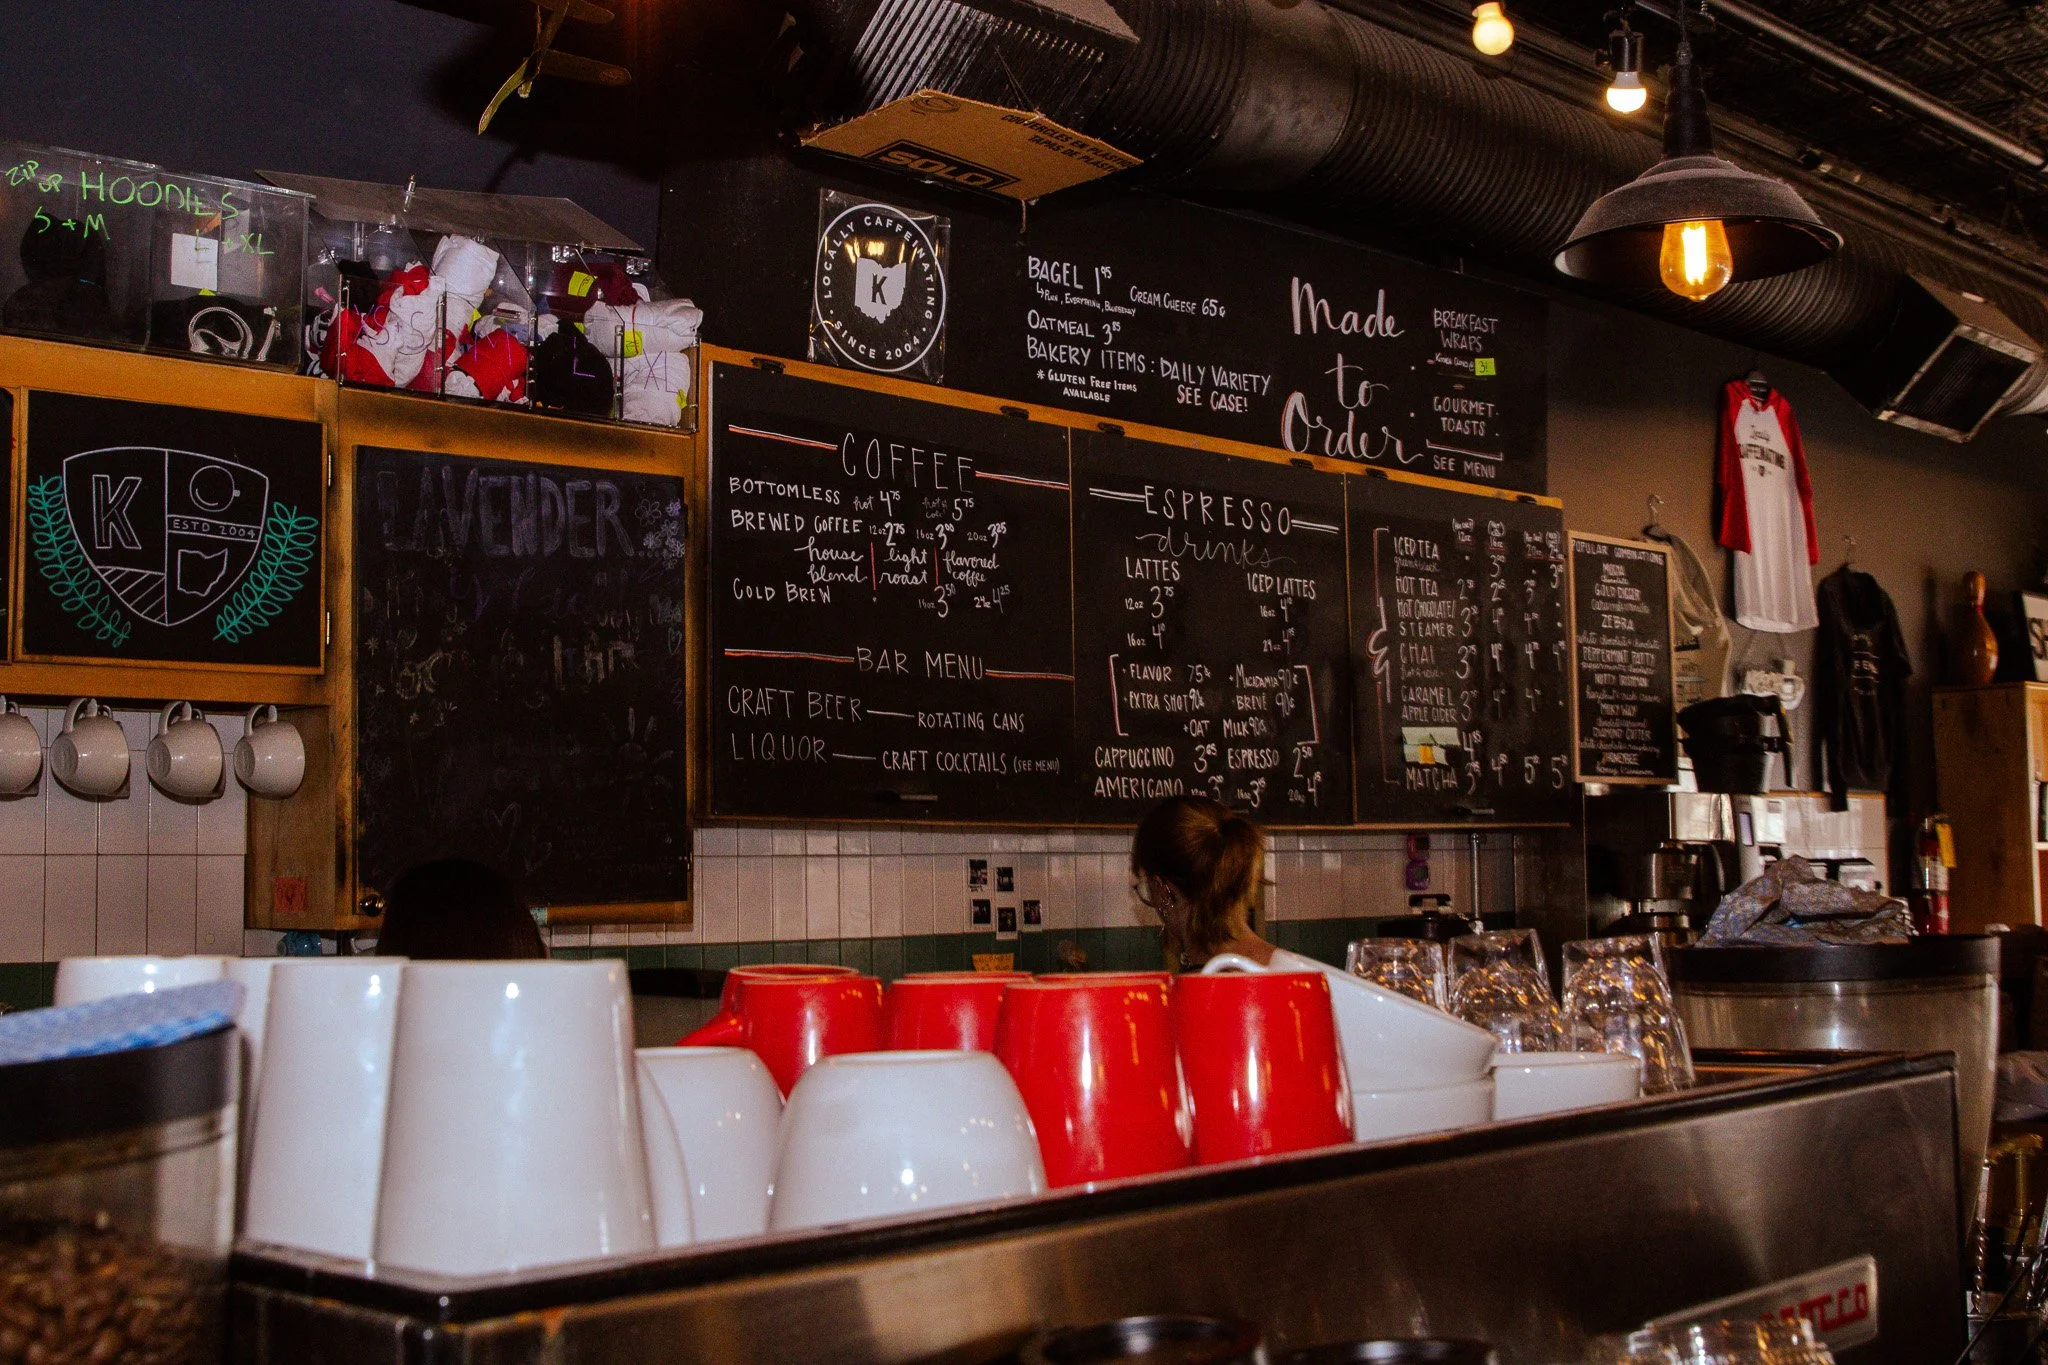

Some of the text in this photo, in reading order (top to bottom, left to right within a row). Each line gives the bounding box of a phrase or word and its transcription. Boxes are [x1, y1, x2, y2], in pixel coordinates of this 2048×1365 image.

[879, 150, 994, 186] SOLO
[82, 171, 240, 220] HOODIES
[83, 213, 111, 241] M
[239, 232, 274, 255] XL
[822, 216, 936, 320] LOCALLY CAFFEINATING
[1028, 256, 1084, 290] BAGEL
[871, 273, 888, 306] K
[1291, 276, 1406, 338] Made
[1433, 307, 1499, 334] BREAKFAST
[1027, 309, 1095, 338] OATMEAL
[833, 320, 921, 361] SINCE 2004
[1440, 330, 1483, 352] WRAPS
[573, 336, 596, 378] L
[642, 348, 678, 394] XL
[1027, 334, 1091, 367] BAKERY
[1160, 356, 1206, 386] DAILY
[1211, 365, 1272, 397] VARIETY
[1063, 387, 1111, 403] AVAILABLE
[1324, 352, 1390, 410] to
[1177, 385, 1249, 414] SEE CASE!
[1433, 396, 1495, 418] GOURMET
[1281, 390, 1424, 464] Order
[1440, 416, 1486, 437] TOASTS
[842, 432, 973, 493] COFFEE
[1433, 455, 1495, 479] SEE MENU
[729, 477, 840, 505] BOTTOMLESS
[853, 495, 874, 511] hot
[92, 474, 143, 550] K
[731, 509, 805, 532] BREWED
[814, 515, 863, 535] COFFEE
[1144, 485, 1291, 536] ESPRESSO
[172, 519, 257, 539] ESTD 2004
[797, 536, 1000, 577] house light flavored
[1135, 526, 1297, 569] drinks
[1394, 536, 1439, 560] ICED TEA
[807, 564, 986, 587] blend roast coffee
[1125, 557, 1181, 582] LATTES
[1276, 576, 1316, 600] LATTES
[1396, 576, 1439, 597] HOT TEA
[733, 578, 775, 602] COLD
[786, 581, 831, 603] BREW
[1400, 621, 1455, 638] STEAMER
[1601, 614, 1635, 631] ZEBRA
[856, 646, 983, 680] BAR MENU
[1400, 643, 1435, 664] CHAI
[1129, 663, 1172, 681] FLAVOR
[728, 685, 1024, 733] CRAFT BEER ROTATING CANS
[1129, 690, 1160, 710] EXTRA
[1163, 694, 1188, 712] SHOT
[1401, 685, 1455, 707] CARAMEL
[1402, 705, 1458, 722] APPLE CIDER
[1223, 718, 1249, 738] MILK
[732, 732, 827, 763] LIQUOR
[882, 750, 928, 772] CRAFT
[936, 751, 1007, 774] COCKTAILS
[1095, 746, 1174, 768] CAPPUCCINO
[1227, 748, 1279, 769] ESPRESSO
[1094, 776, 1183, 799] AMERICANO
[1406, 767, 1458, 791] MATCHA
